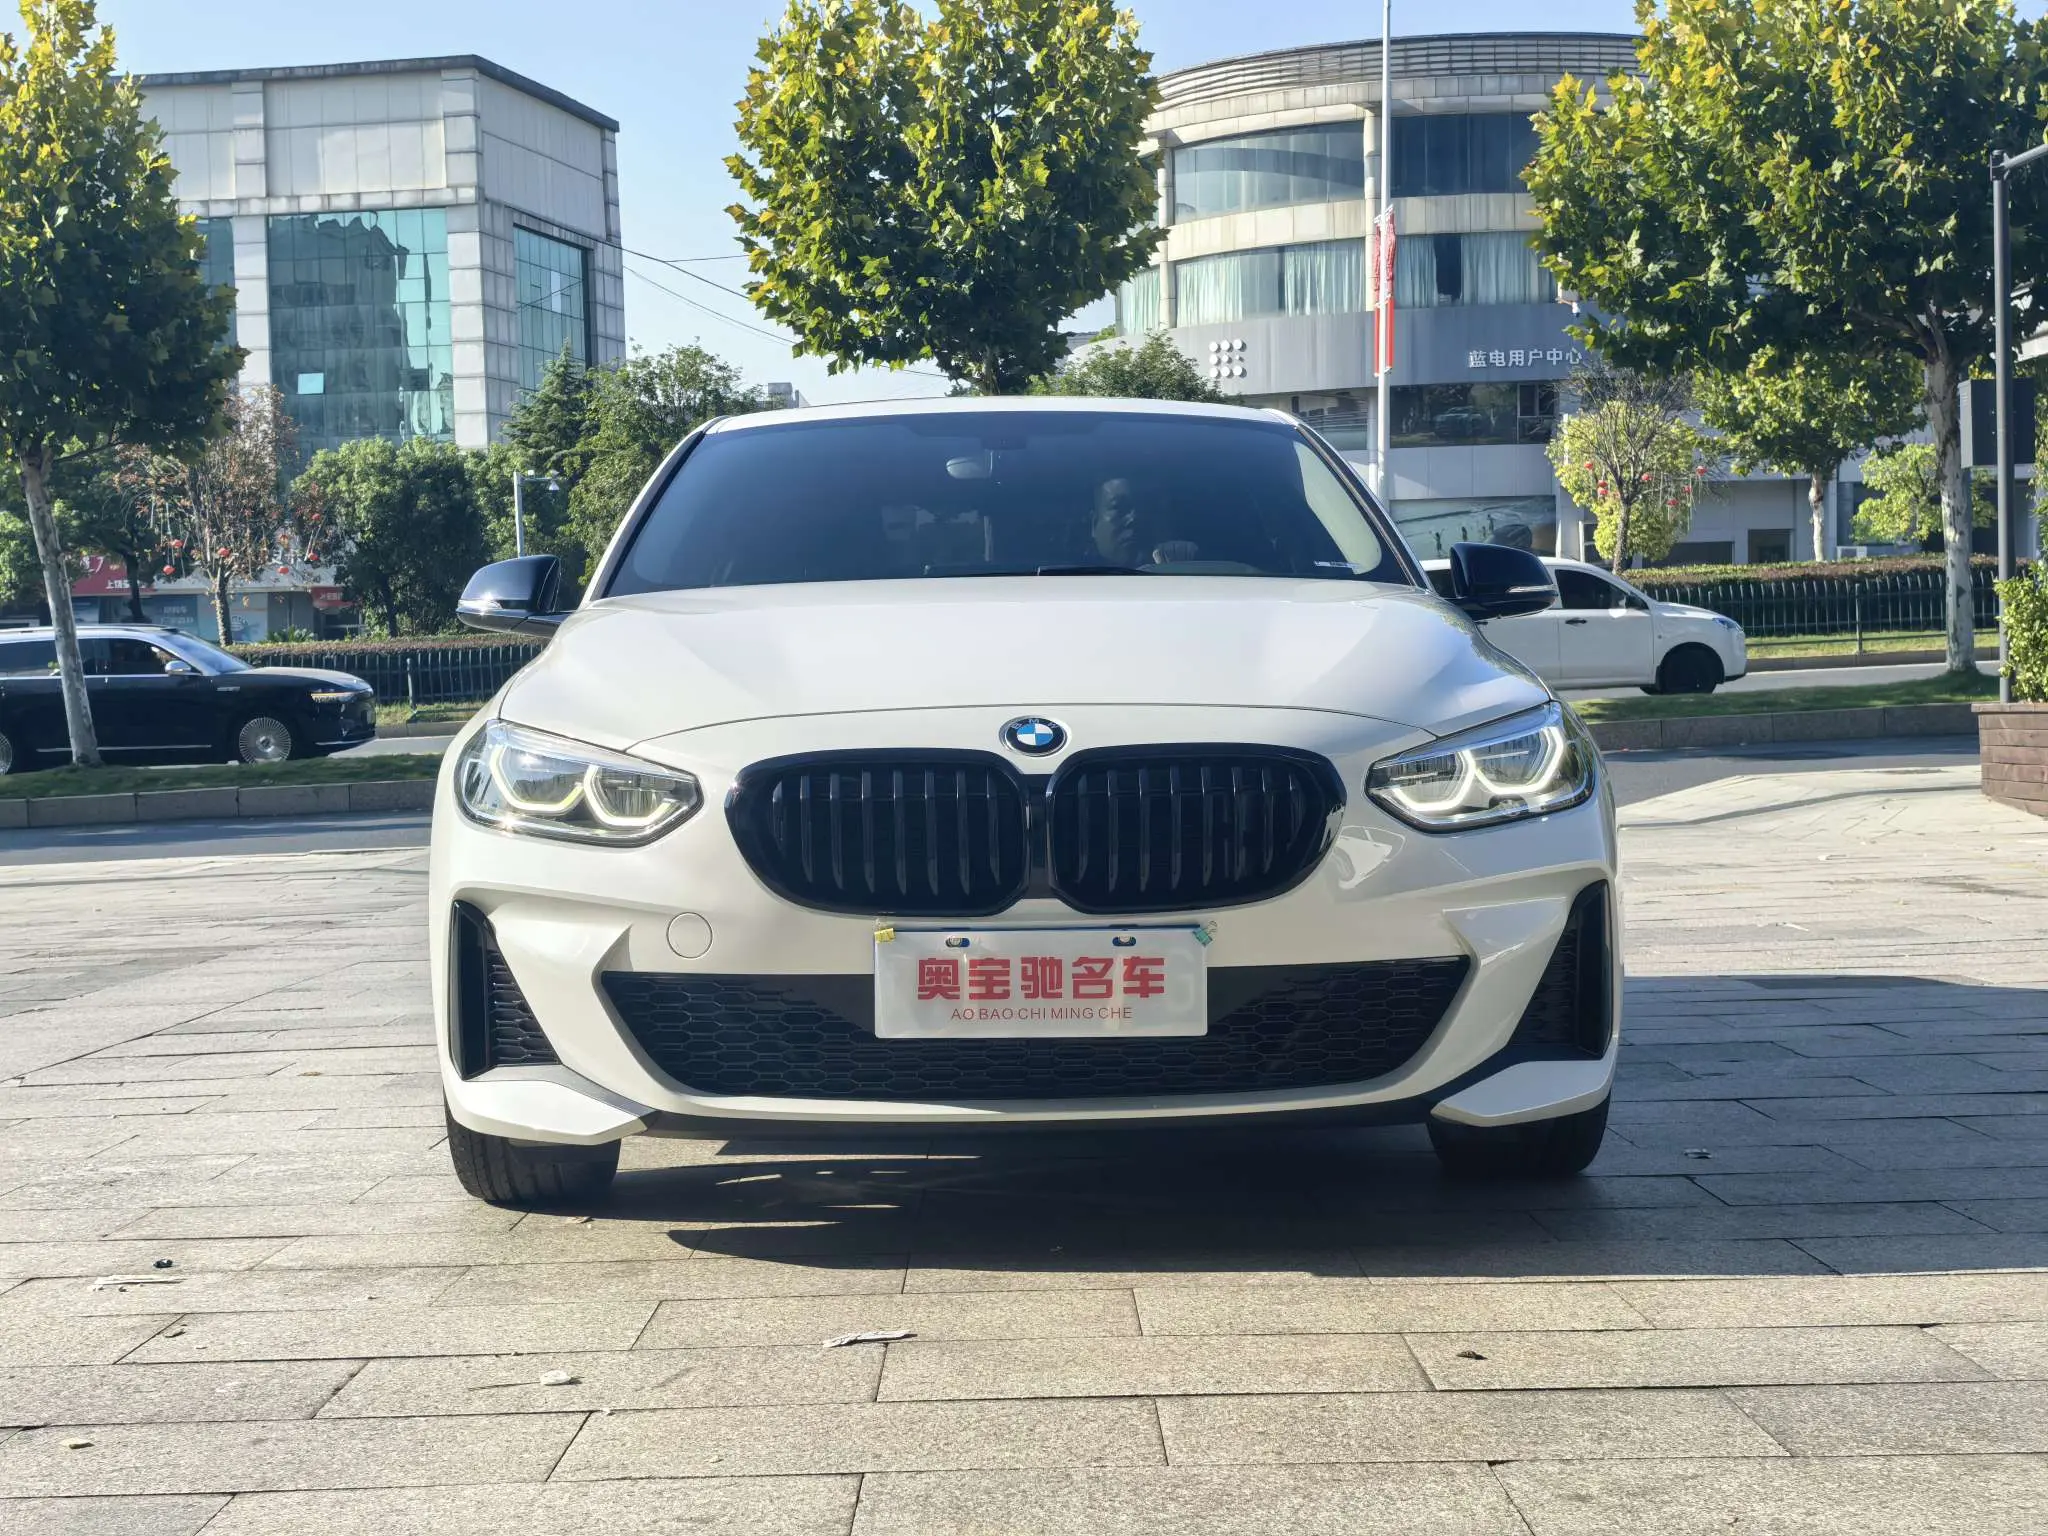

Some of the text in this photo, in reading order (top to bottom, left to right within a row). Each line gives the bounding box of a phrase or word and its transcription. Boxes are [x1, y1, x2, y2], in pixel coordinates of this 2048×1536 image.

[1468, 347, 1582, 368] 蓝电用户中心
[1010, 719, 1060, 730] BMW
[917, 956, 1165, 1000] 奥宝驰名车
[951, 1007, 1132, 1020] AO BAO CHI MING CHE
